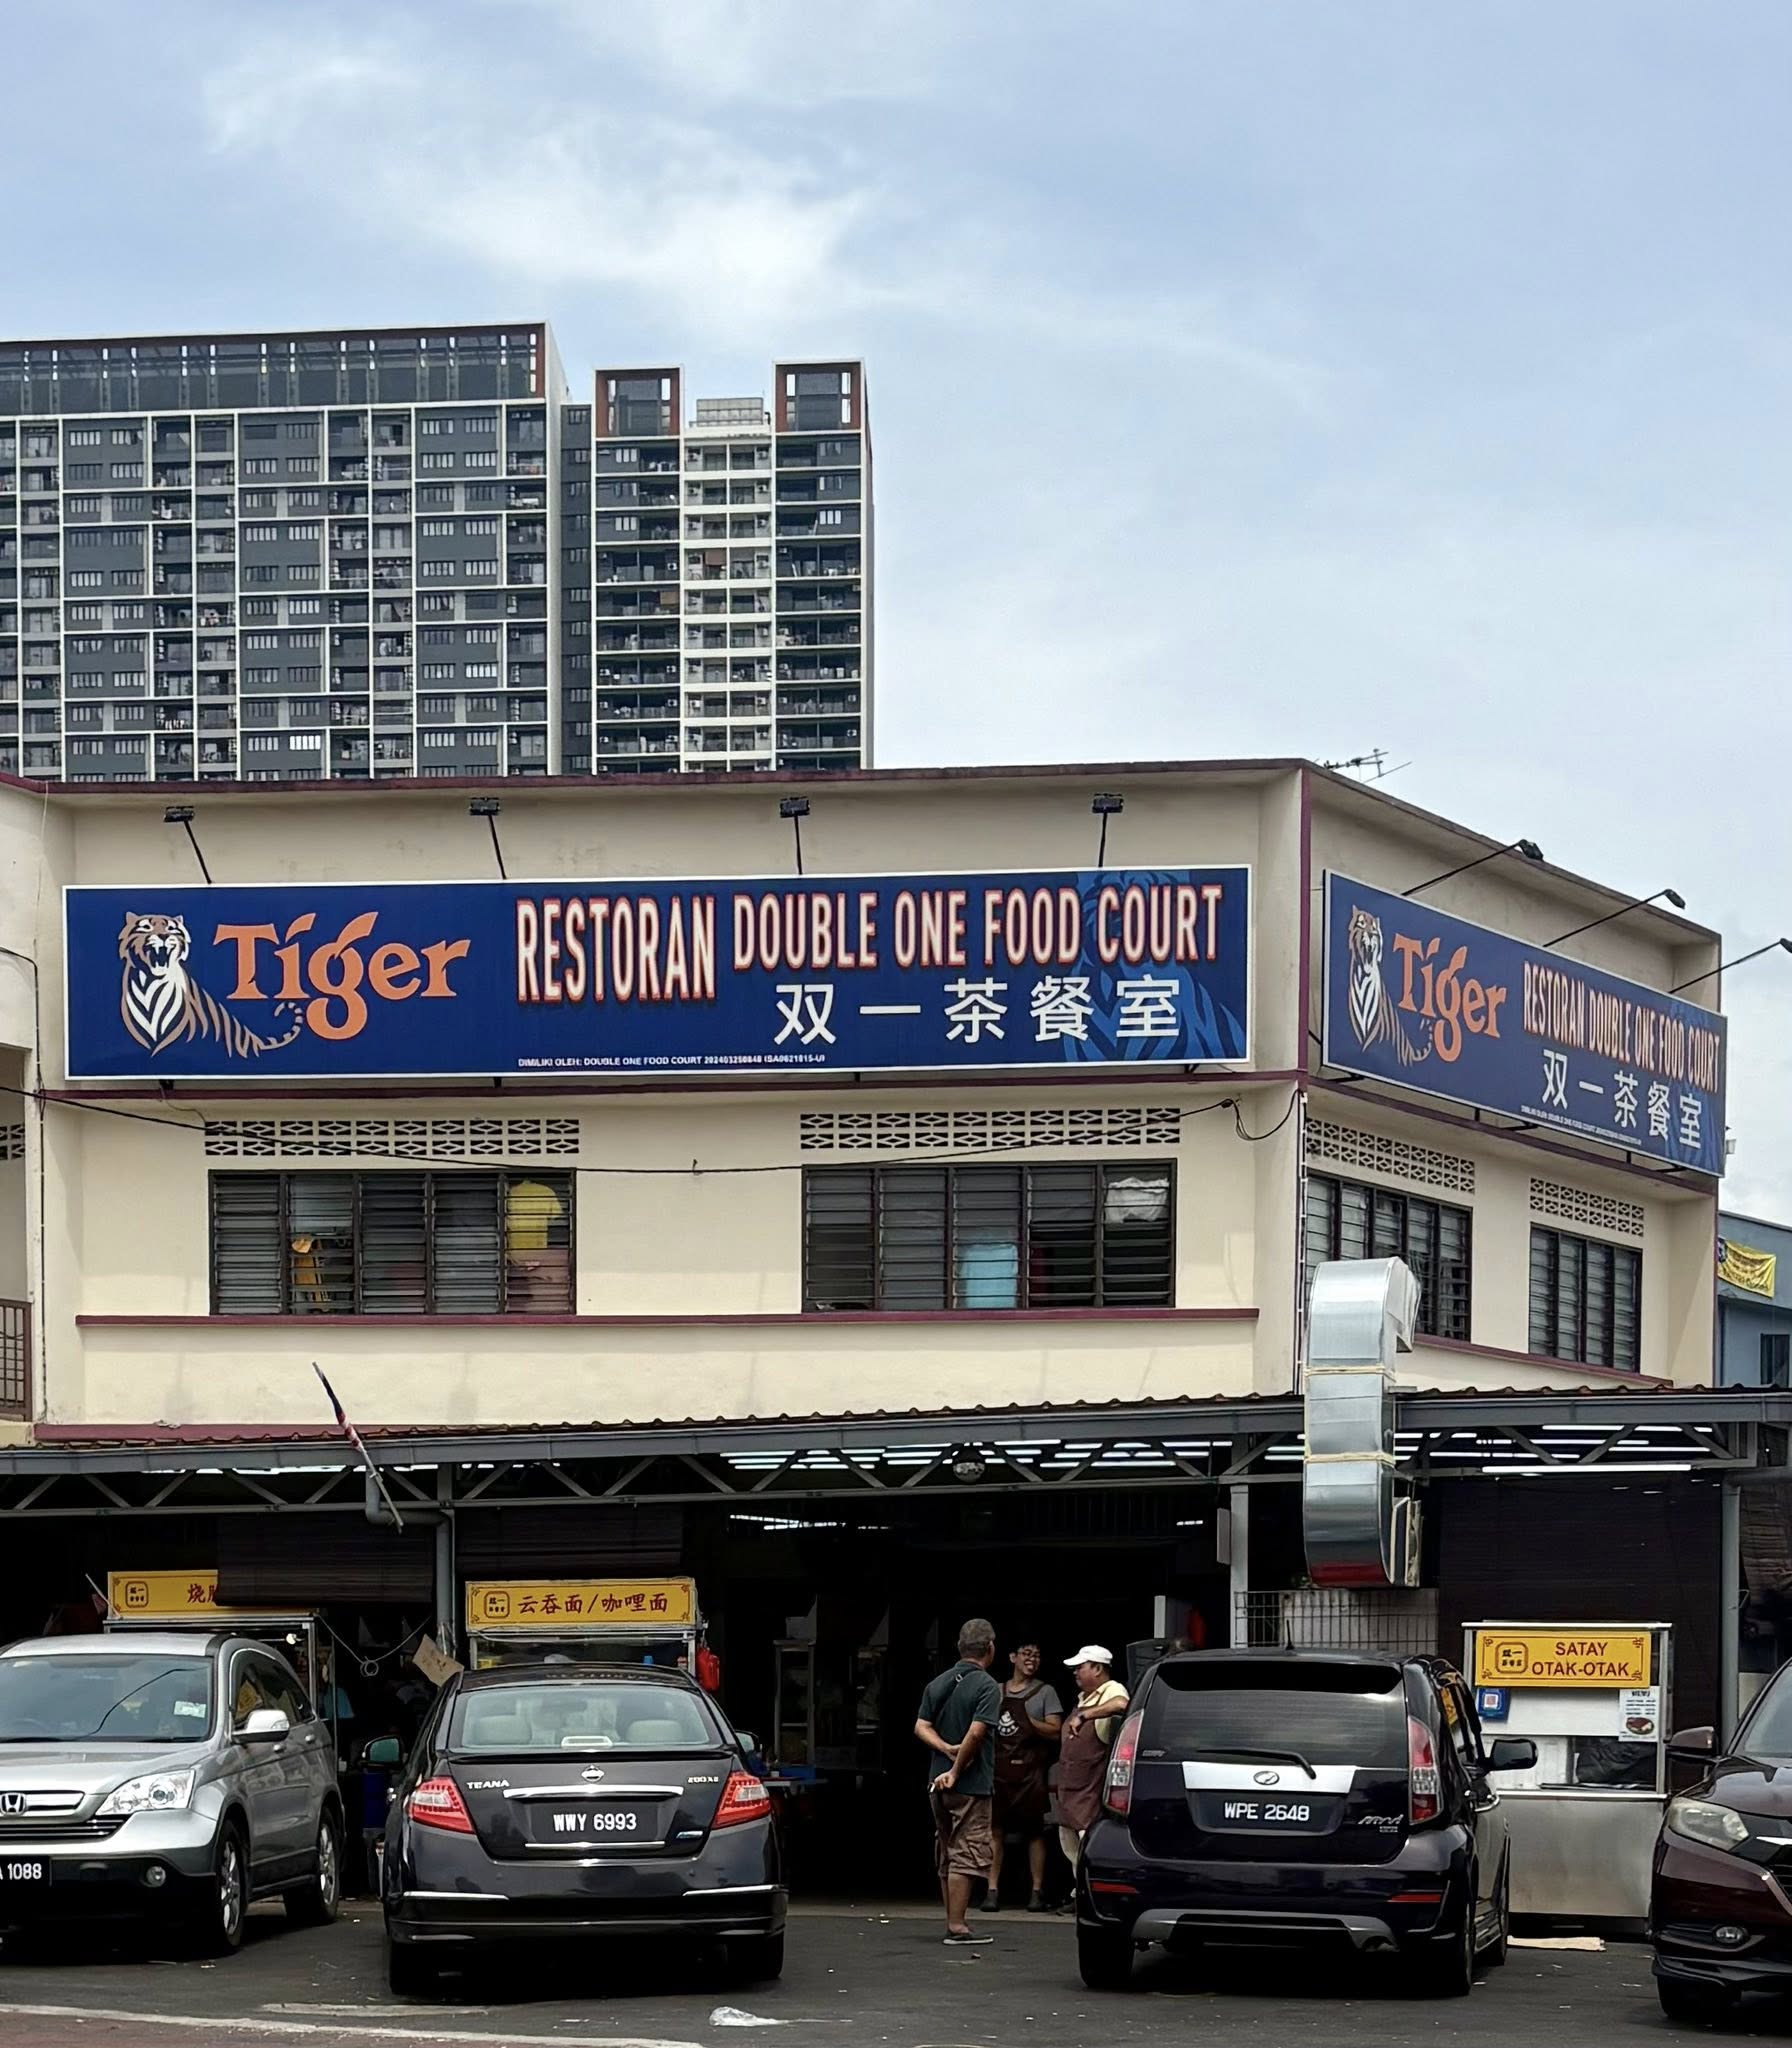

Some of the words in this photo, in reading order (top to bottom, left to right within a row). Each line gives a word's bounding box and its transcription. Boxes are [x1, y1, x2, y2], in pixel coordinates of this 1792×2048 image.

[516, 894, 717, 1004] RESTORAN
[733, 892, 878, 972] DOUBLE
[894, 890, 967, 968] ONE
[984, 887, 1082, 966] FOOD
[1099, 883, 1223, 964] COURT
[213, 911, 470, 1040] Tiger
[1392, 933, 1507, 1063] Tiger
[773, 973, 1180, 1045] 双一茶餐室
[1523, 960, 1585, 1049] RESTORAN
[1588, 988, 1631, 1064] DOUBLE
[1634, 1005, 1655, 1071] ONE
[1657, 1013, 1685, 1082] FOOD
[1688, 1025, 1720, 1094] COURT
[584, 1057, 620, 1066] DOUBLE
[622, 1057, 642, 1065] ONE
[644, 1056, 669, 1065] FOOD
[671, 1056, 701, 1064] COURT
[1542, 1049, 1702, 1149] 双一茶餐室
[1555, 1641, 1608, 1656] SATAY
[1532, 1661, 1630, 1677] OTAK-OTAK
[466, 1779, 510, 1790] TEANA
[1224, 1802, 1259, 1820] WPE
[1264, 1803, 1310, 1821] 2648
[553, 1814, 587, 1832] WWY
[593, 1812, 637, 1831] 6993
[7, 1863, 42, 1880] 1088
